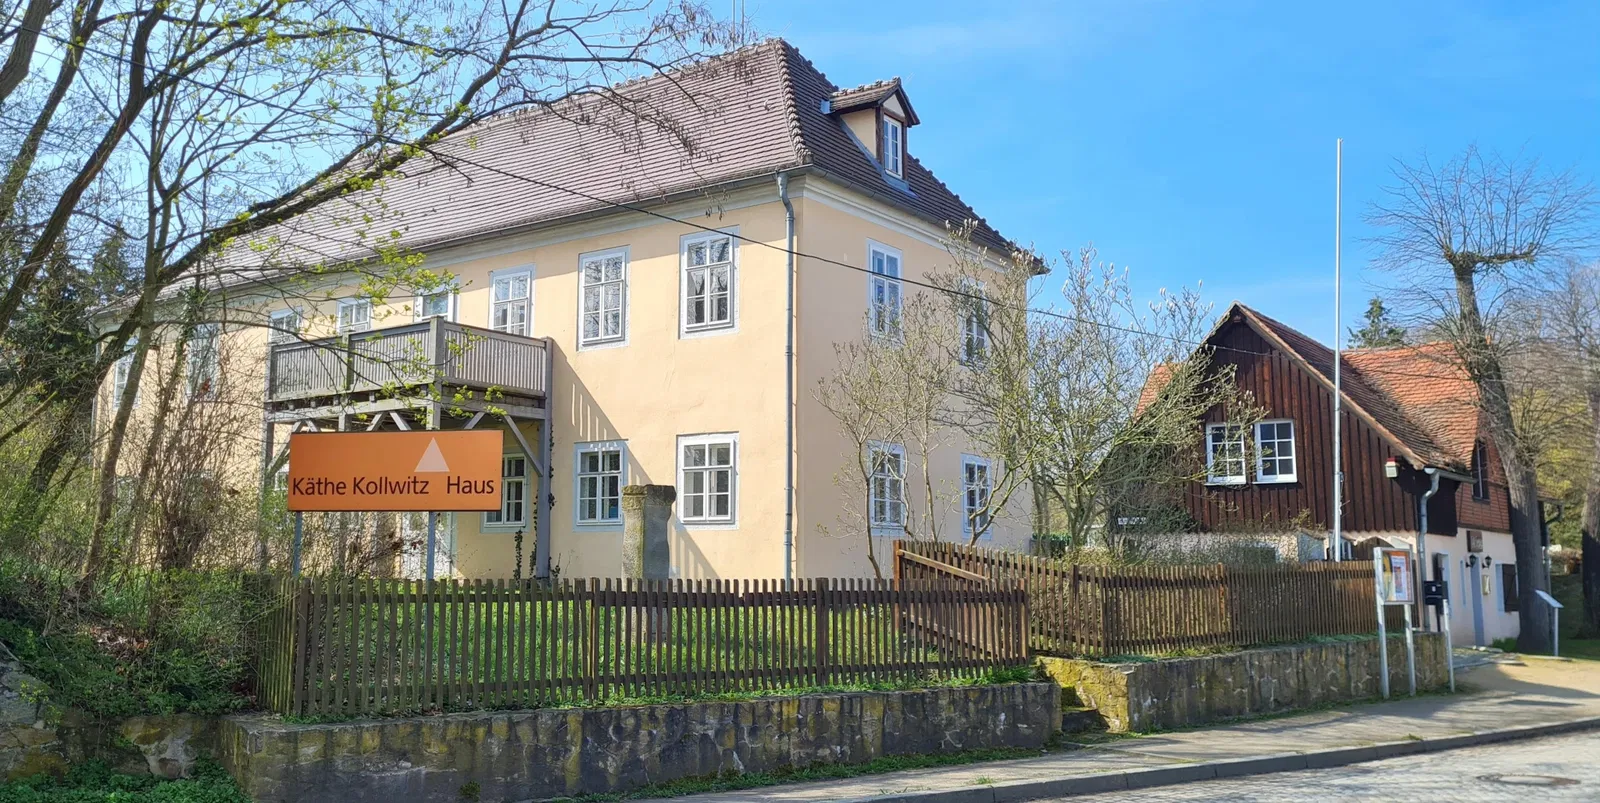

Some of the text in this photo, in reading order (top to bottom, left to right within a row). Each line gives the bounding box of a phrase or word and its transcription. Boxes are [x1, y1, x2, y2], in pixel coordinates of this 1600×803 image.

[292, 475, 495, 495] Käthe Kollwitz Haus
